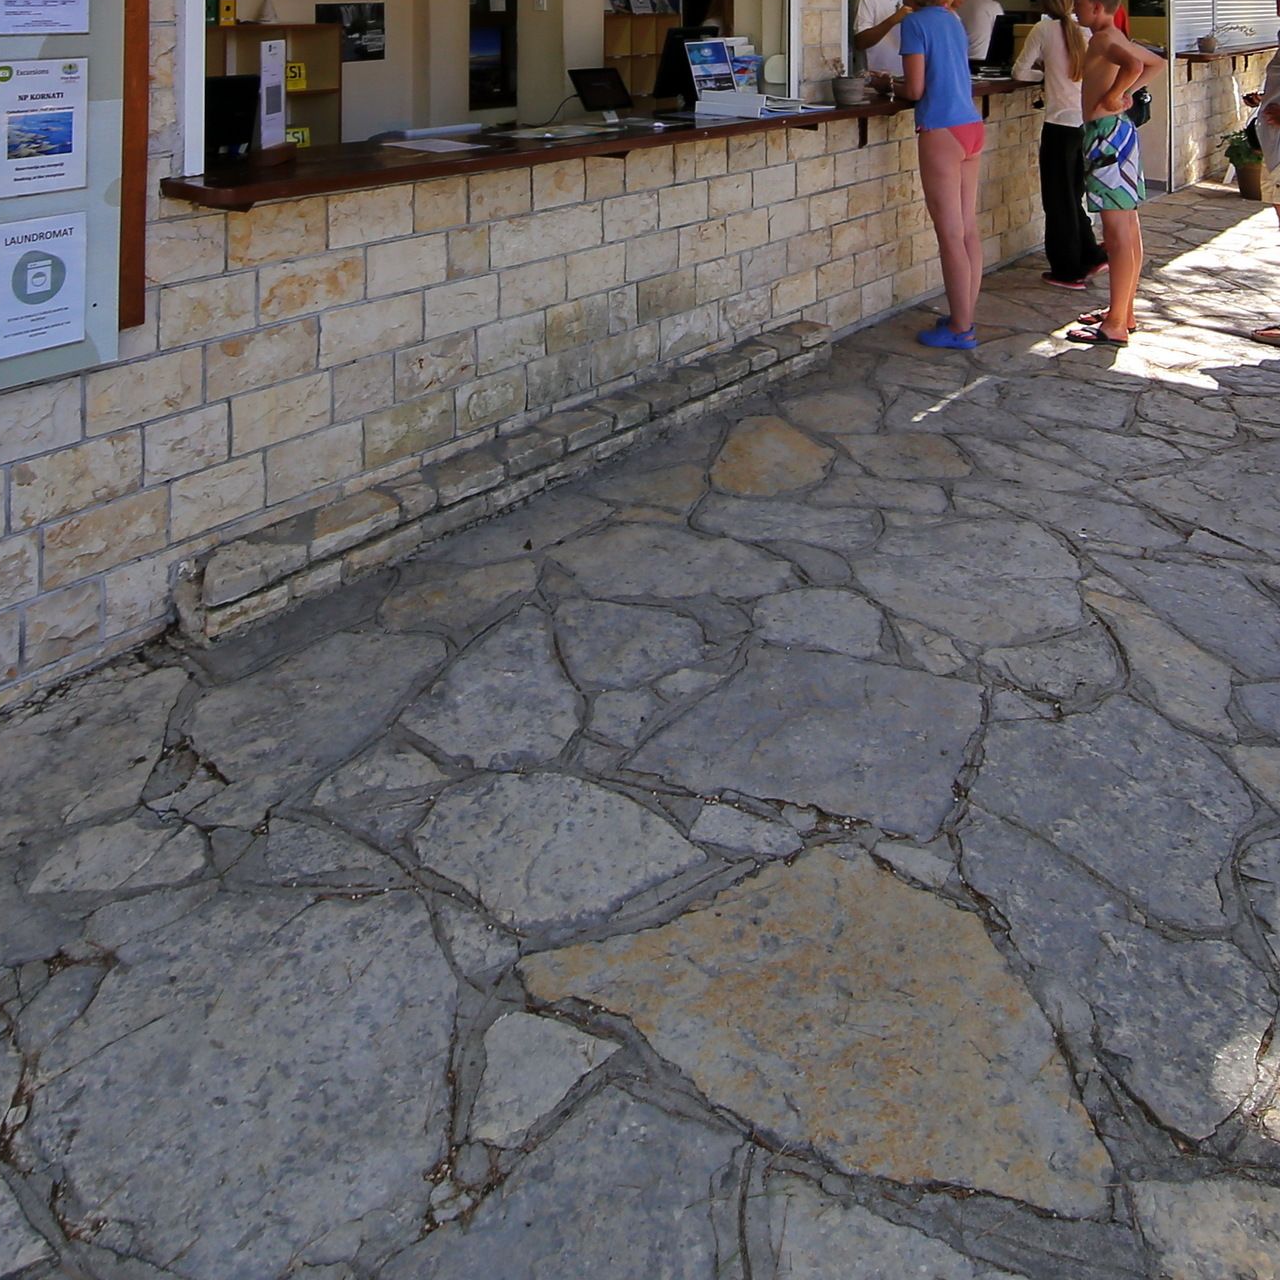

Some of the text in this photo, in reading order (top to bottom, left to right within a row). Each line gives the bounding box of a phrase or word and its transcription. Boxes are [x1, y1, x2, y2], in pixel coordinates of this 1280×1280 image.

[16, 68, 50, 77] Excursions
[30, 92, 65, 101] KORNATI
[4, 227, 74, 246] LAUNDROMAT
